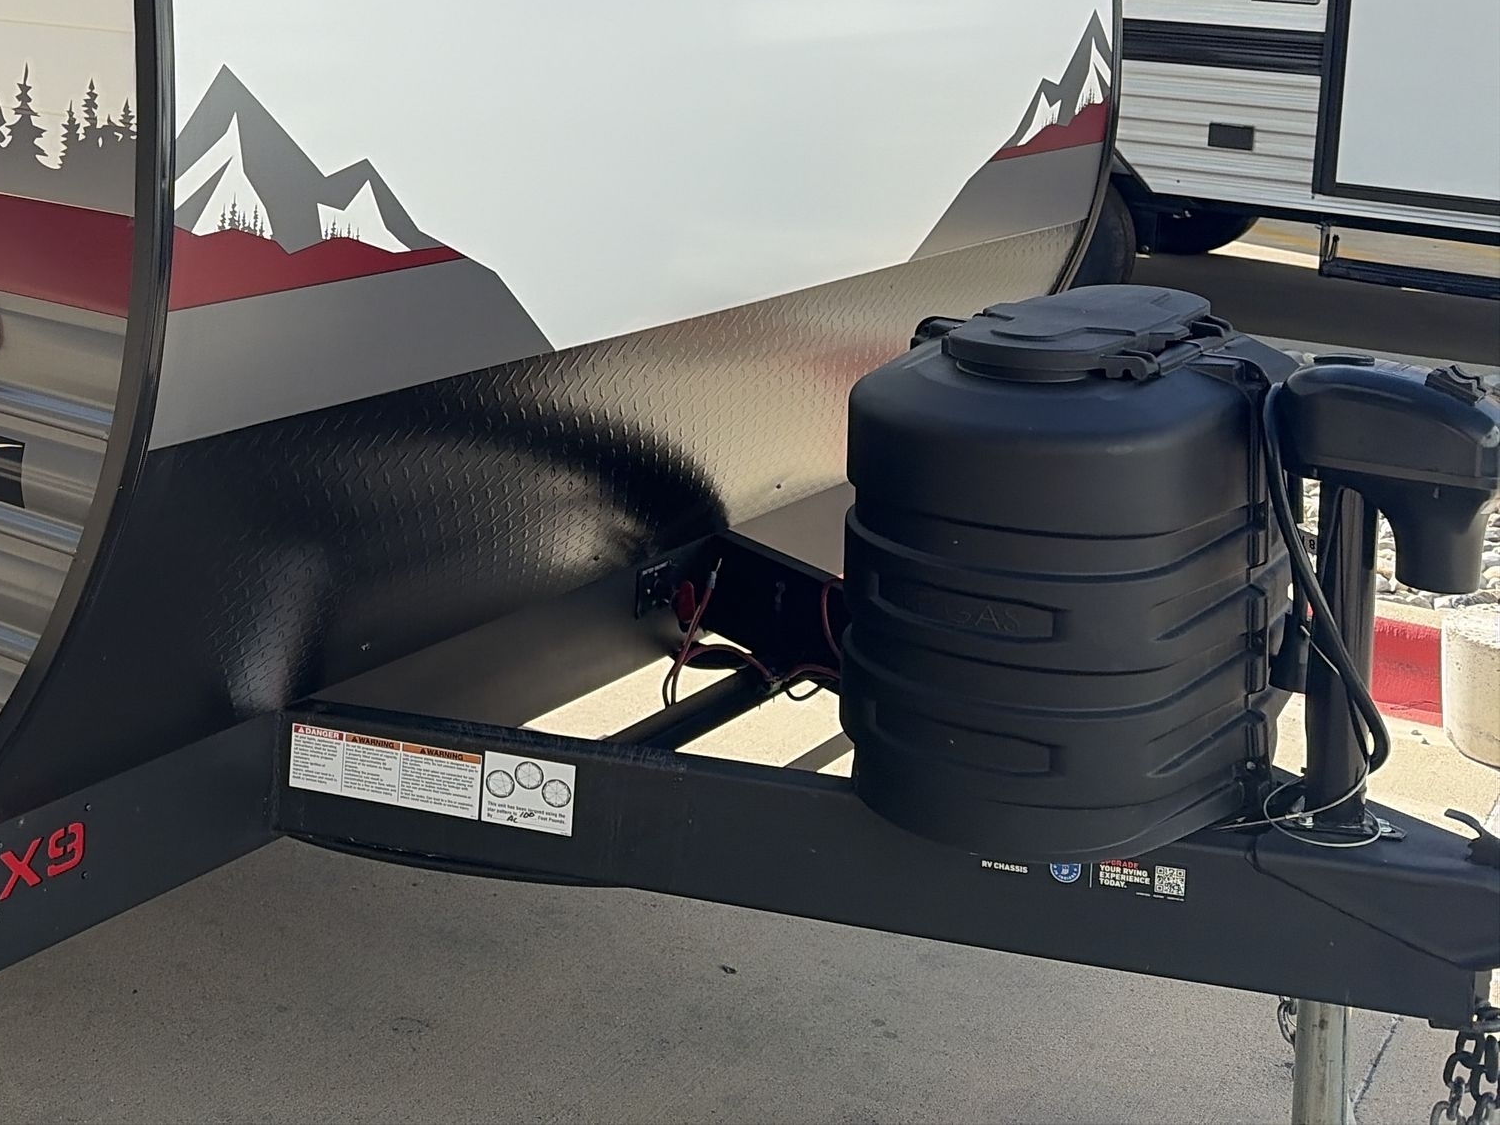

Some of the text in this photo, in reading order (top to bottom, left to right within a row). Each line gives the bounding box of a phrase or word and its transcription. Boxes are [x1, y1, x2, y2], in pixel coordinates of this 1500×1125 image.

[305, 727, 340, 740] DANGER
[358, 737, 395, 749] WARNING
[427, 748, 464, 761] WARNING
[981, 859, 1029, 874] RV CHASSIS
[1099, 864, 1149, 878] YOUR RVING
[1098, 877, 1128, 889] TODAY.
[1099, 871, 1151, 885] EXPERIENCE
